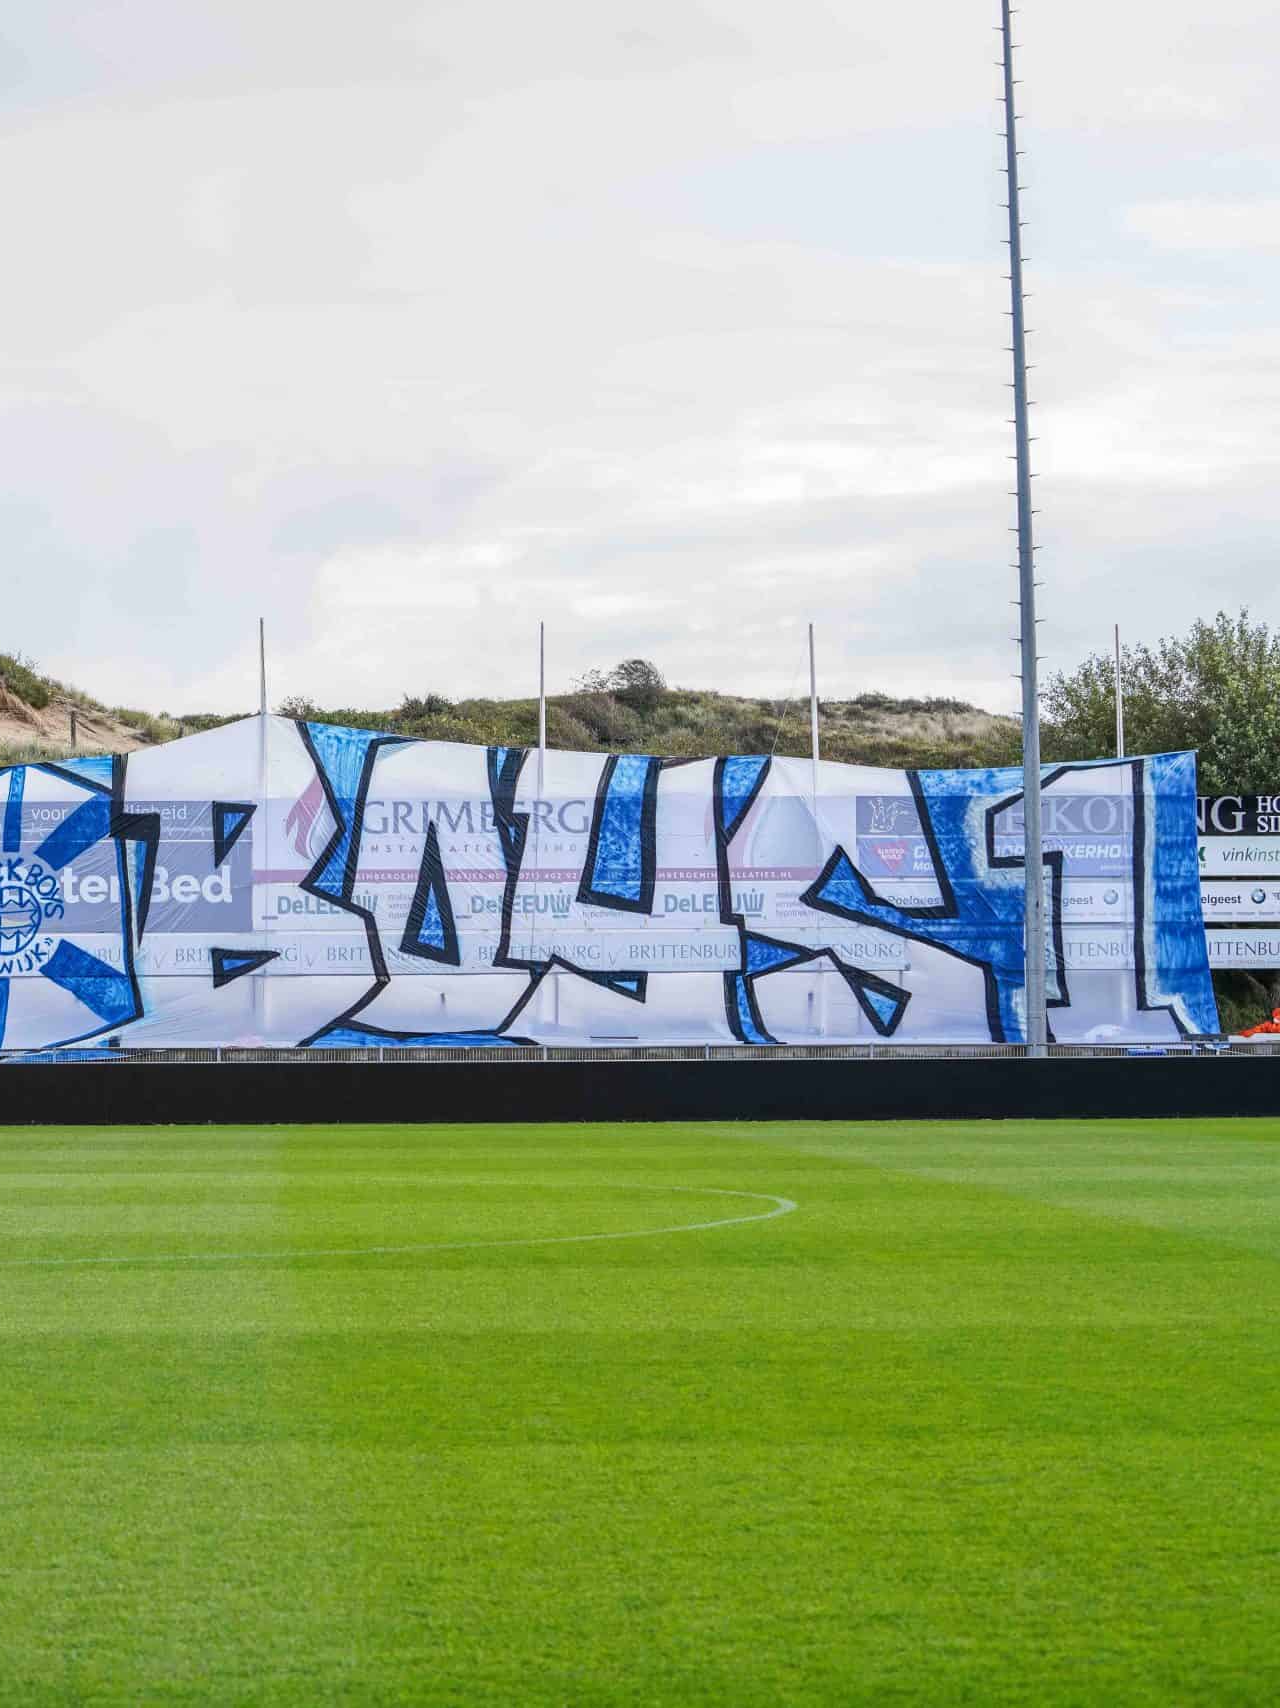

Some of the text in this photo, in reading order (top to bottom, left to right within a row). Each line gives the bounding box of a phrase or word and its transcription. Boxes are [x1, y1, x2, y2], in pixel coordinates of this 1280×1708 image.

[31, 806, 68, 820] voor
[24, 863, 65, 920] BOYS
[1200, 893, 1243, 906] elgeest
[629, 943, 738, 960] BRITTENBUR
